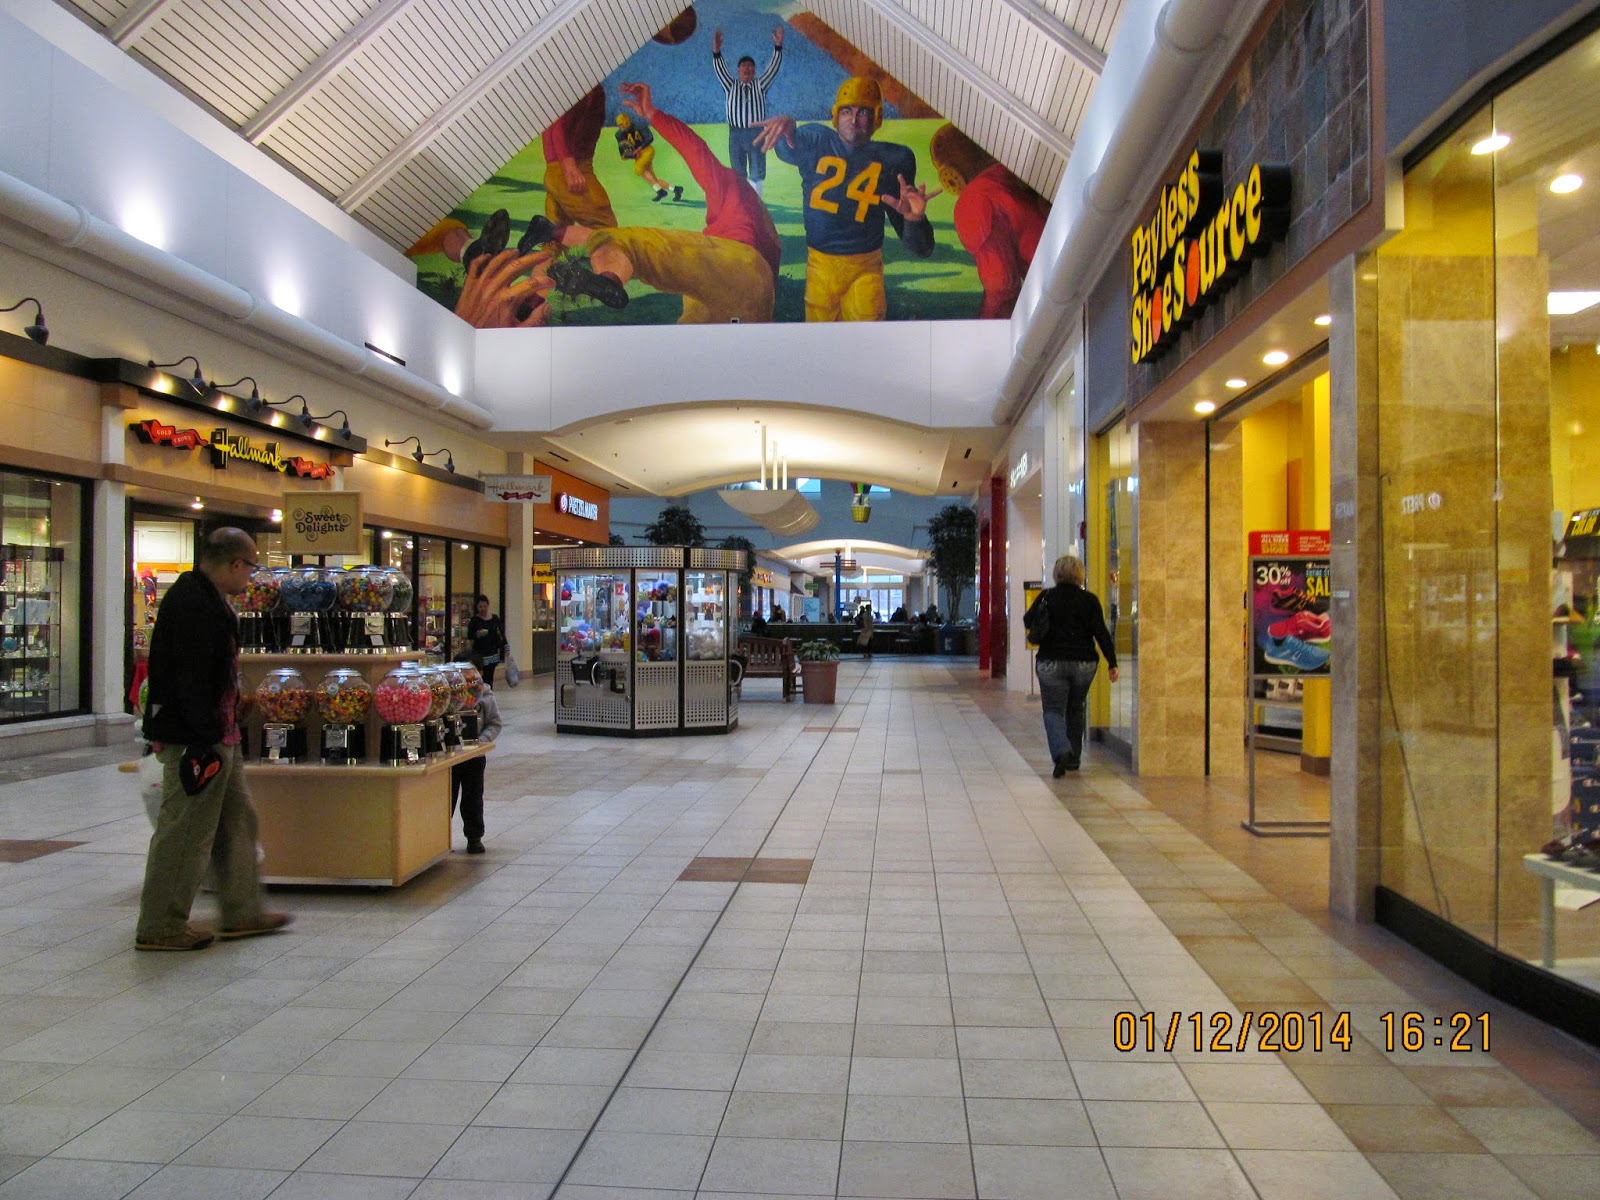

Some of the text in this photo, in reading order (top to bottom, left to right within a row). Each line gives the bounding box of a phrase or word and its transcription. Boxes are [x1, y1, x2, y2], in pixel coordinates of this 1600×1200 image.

[809, 155, 882, 222] 24
[1131, 149, 1199, 297] Payless
[173, 435, 192, 443] CROWN
[214, 427, 287, 473] Hallmark
[487, 478, 548, 493] Hallmark
[305, 511, 341, 524] Sweet
[295, 522, 345, 534] Delights
[1306, 577, 1331, 597] SAL
